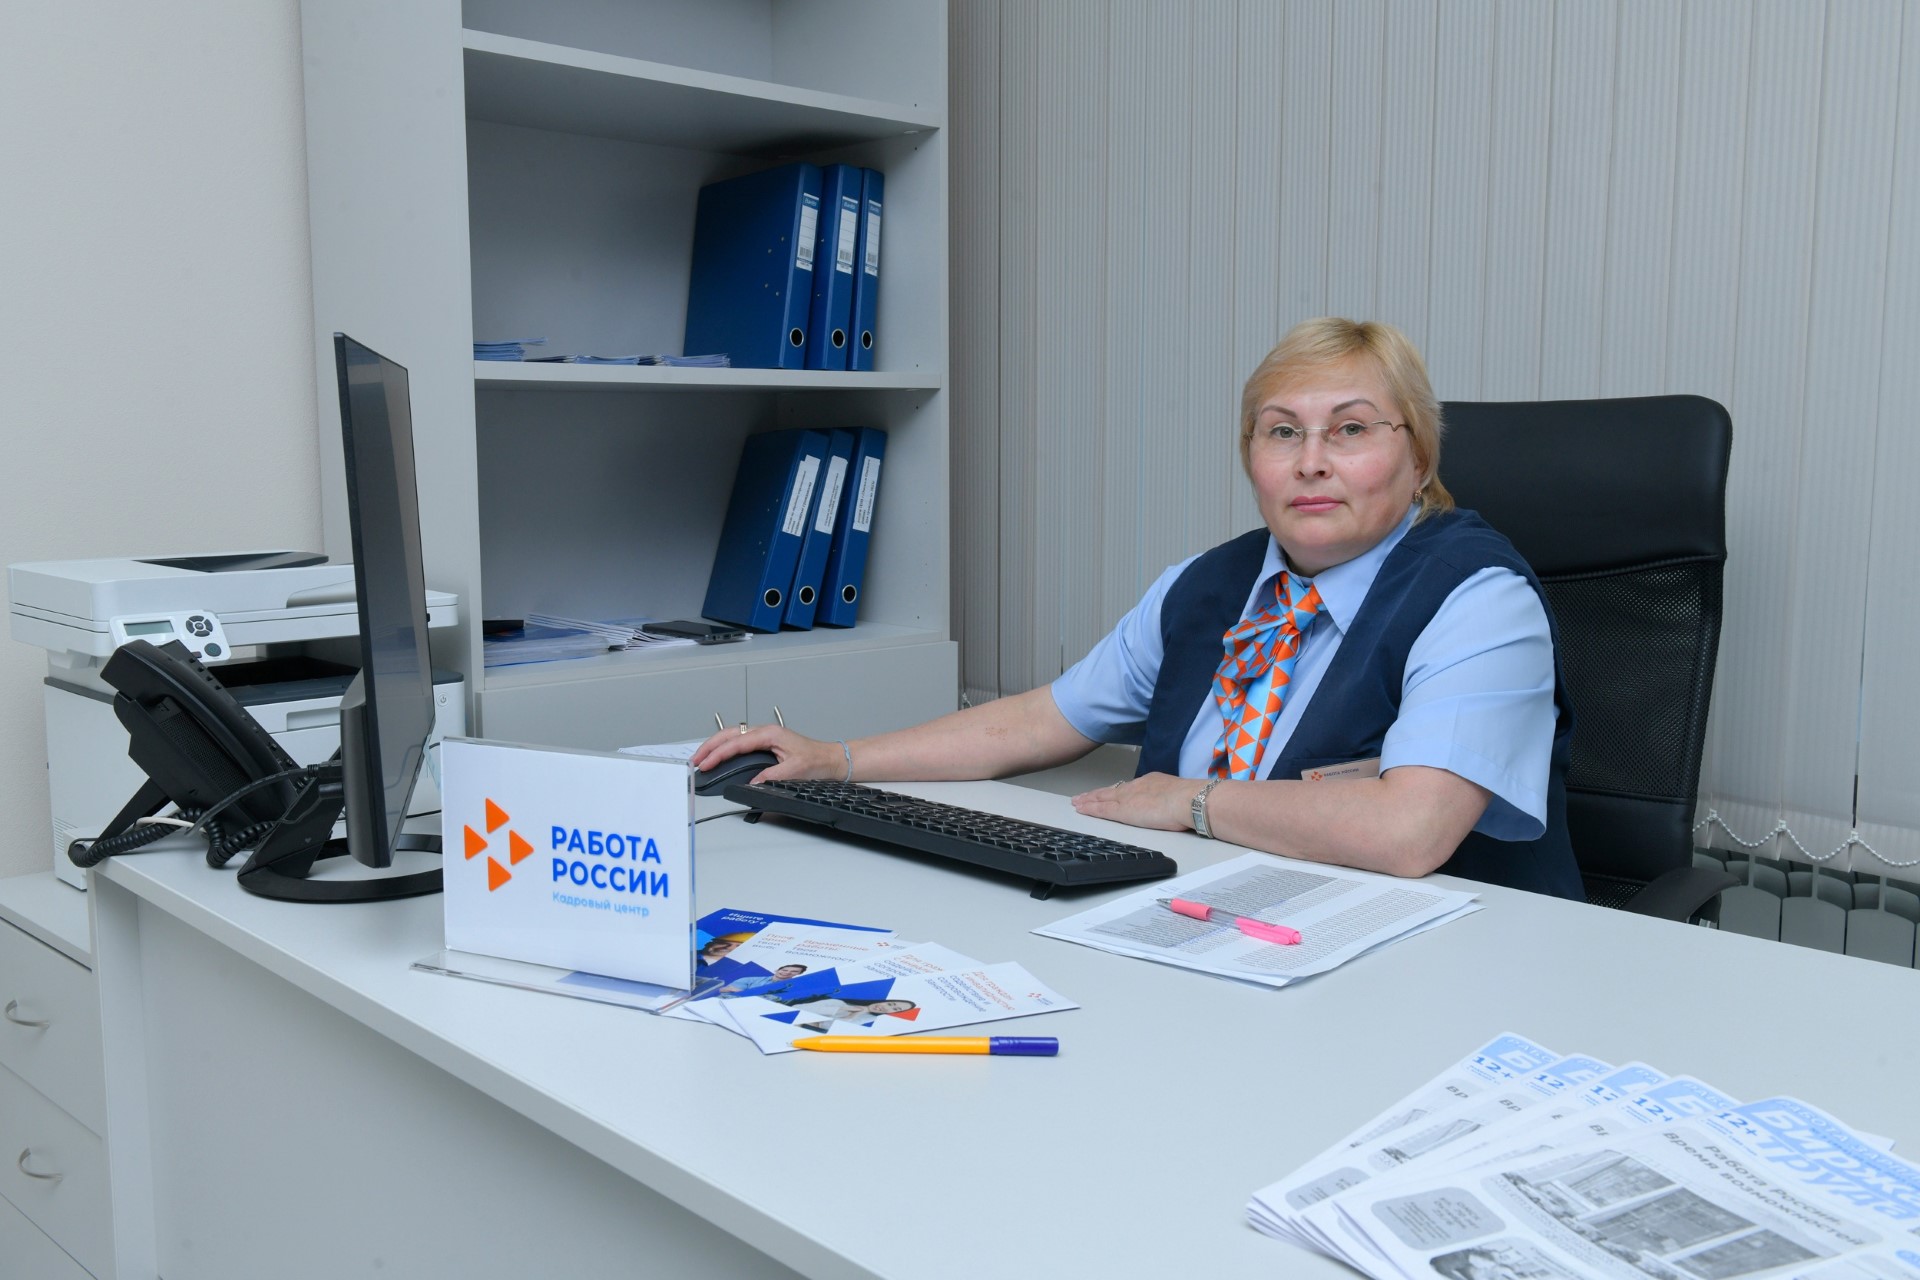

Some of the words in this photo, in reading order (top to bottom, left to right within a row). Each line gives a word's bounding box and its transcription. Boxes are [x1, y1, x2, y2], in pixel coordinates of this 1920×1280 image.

[552, 825, 661, 864] РАБОТА
[552, 858, 668, 898] РОССИИ
[552, 891, 611, 910] Кадровый
[614, 903, 649, 917] центр
[1472, 1056, 1515, 1080] 12+
[1632, 1096, 1674, 1122] 12+
[1714, 1112, 1758, 1137] 12+
[1704, 1145, 1768, 1187] Работа
[1663, 1132, 1720, 1170] Время
[1720, 1172, 1865, 1246] возможностей
